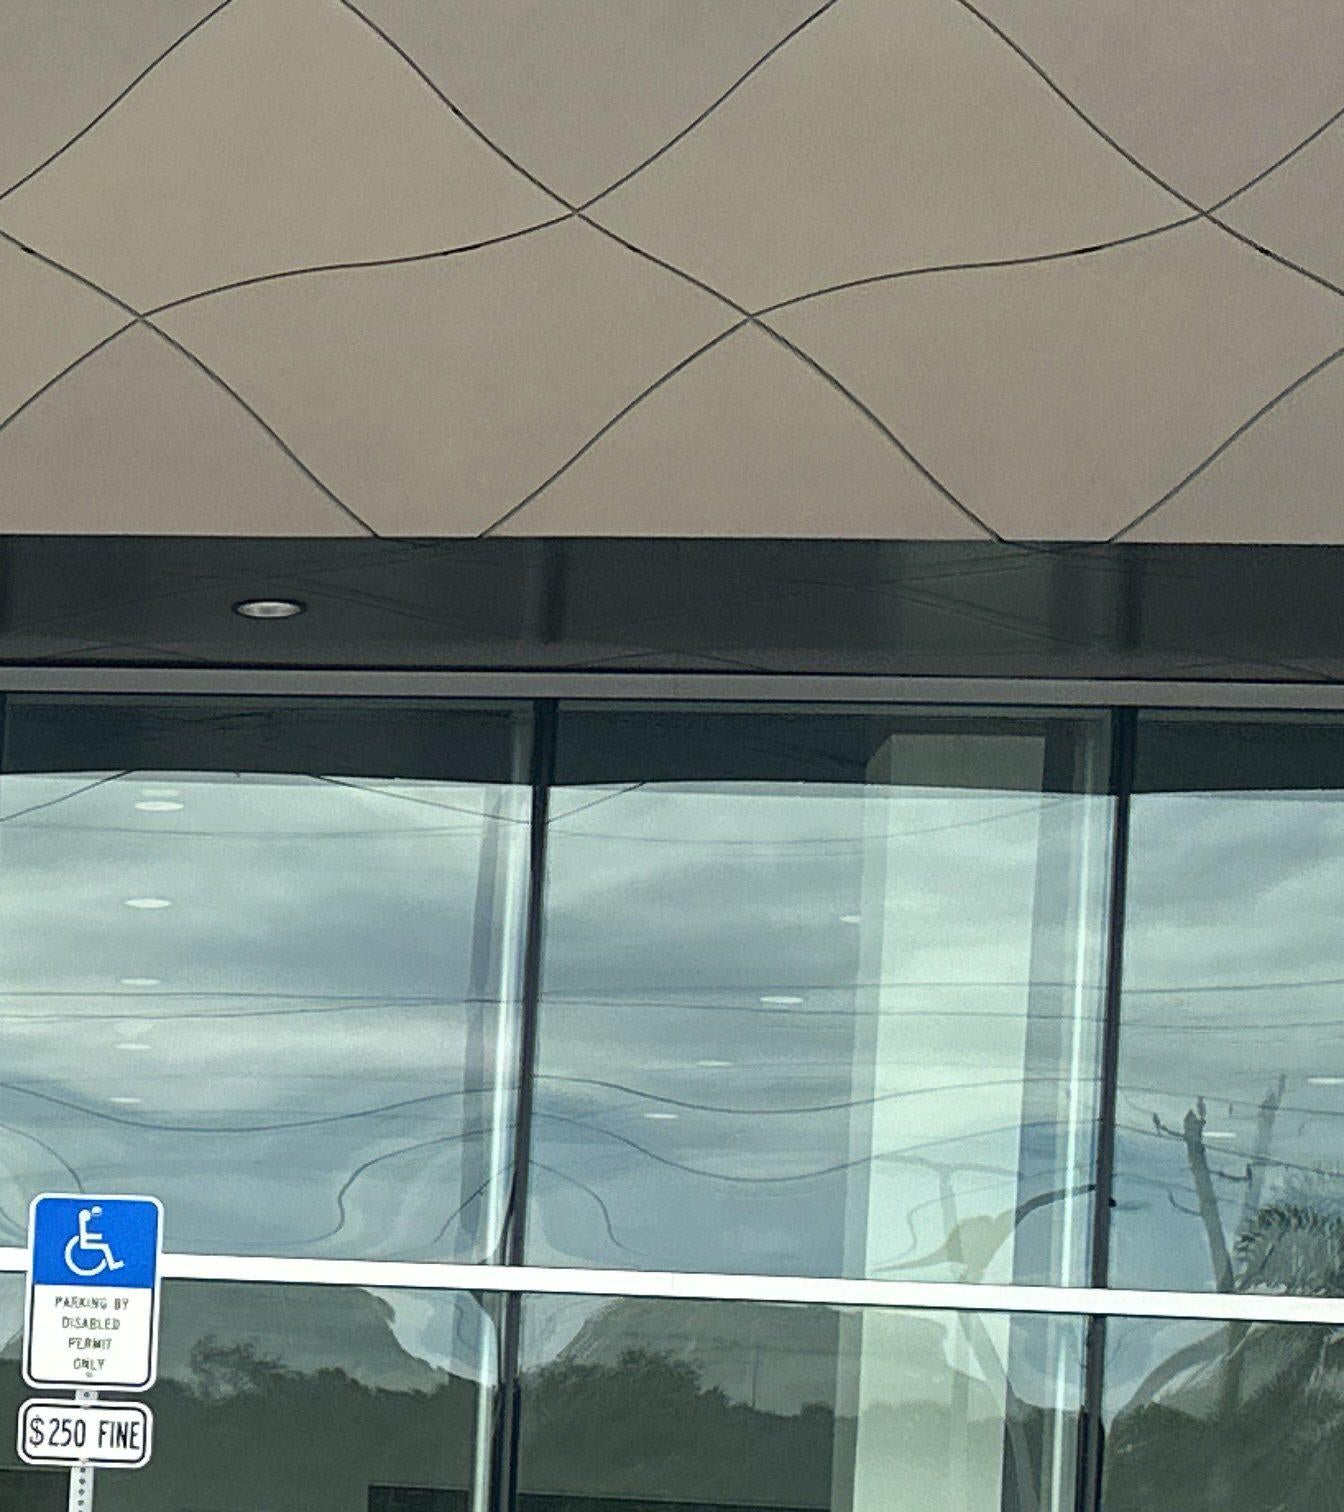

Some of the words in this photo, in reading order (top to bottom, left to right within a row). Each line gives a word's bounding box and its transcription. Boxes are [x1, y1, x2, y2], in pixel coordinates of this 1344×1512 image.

[54, 1297, 107, 1309] PARKING
[113, 1299, 129, 1311] BY
[62, 1317, 121, 1330] DISABLED
[68, 1338, 112, 1350] PERMIT
[73, 1359, 106, 1371] ONLY
[29, 1415, 86, 1448] $250
[99, 1421, 140, 1450] FINE
